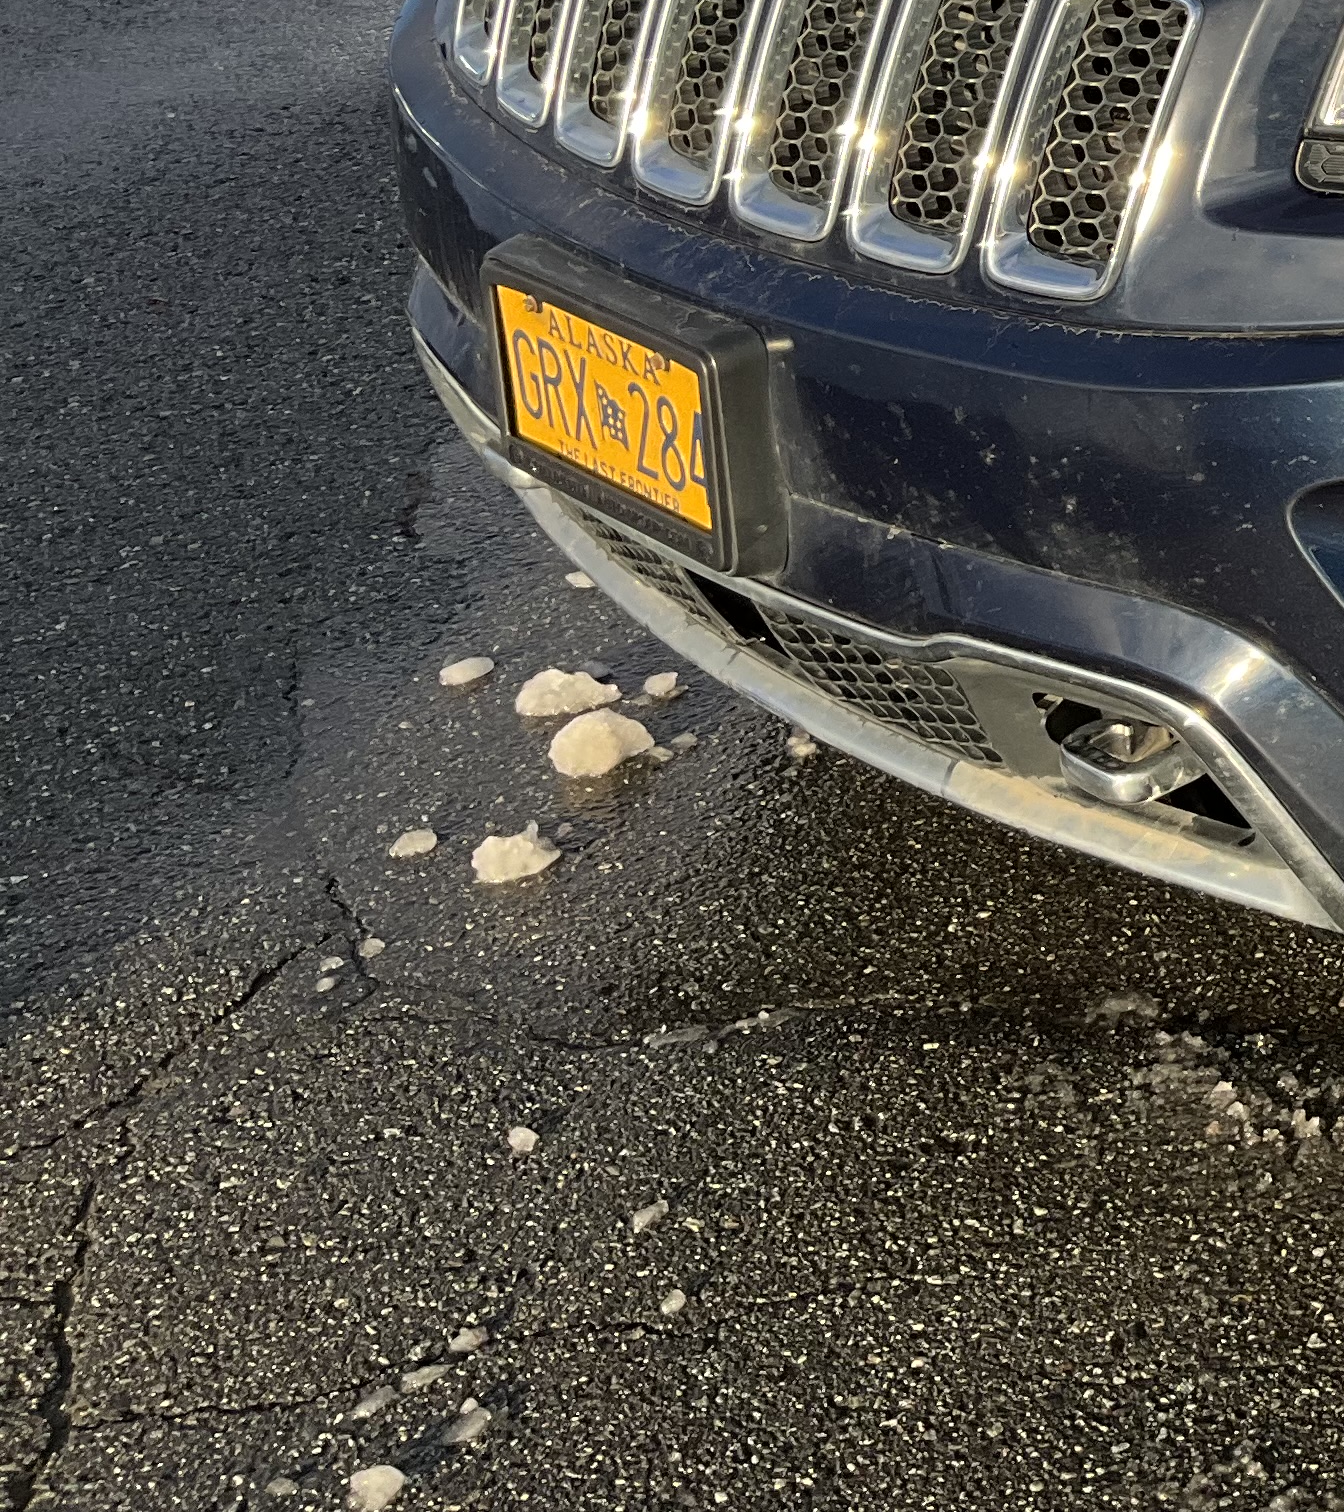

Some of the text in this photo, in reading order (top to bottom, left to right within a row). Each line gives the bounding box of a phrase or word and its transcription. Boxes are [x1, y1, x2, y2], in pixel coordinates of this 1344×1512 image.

[548, 309, 661, 386] ALASKA
[512, 329, 598, 451] GRX
[558, 440, 682, 514] THE LAST FRONTIER
